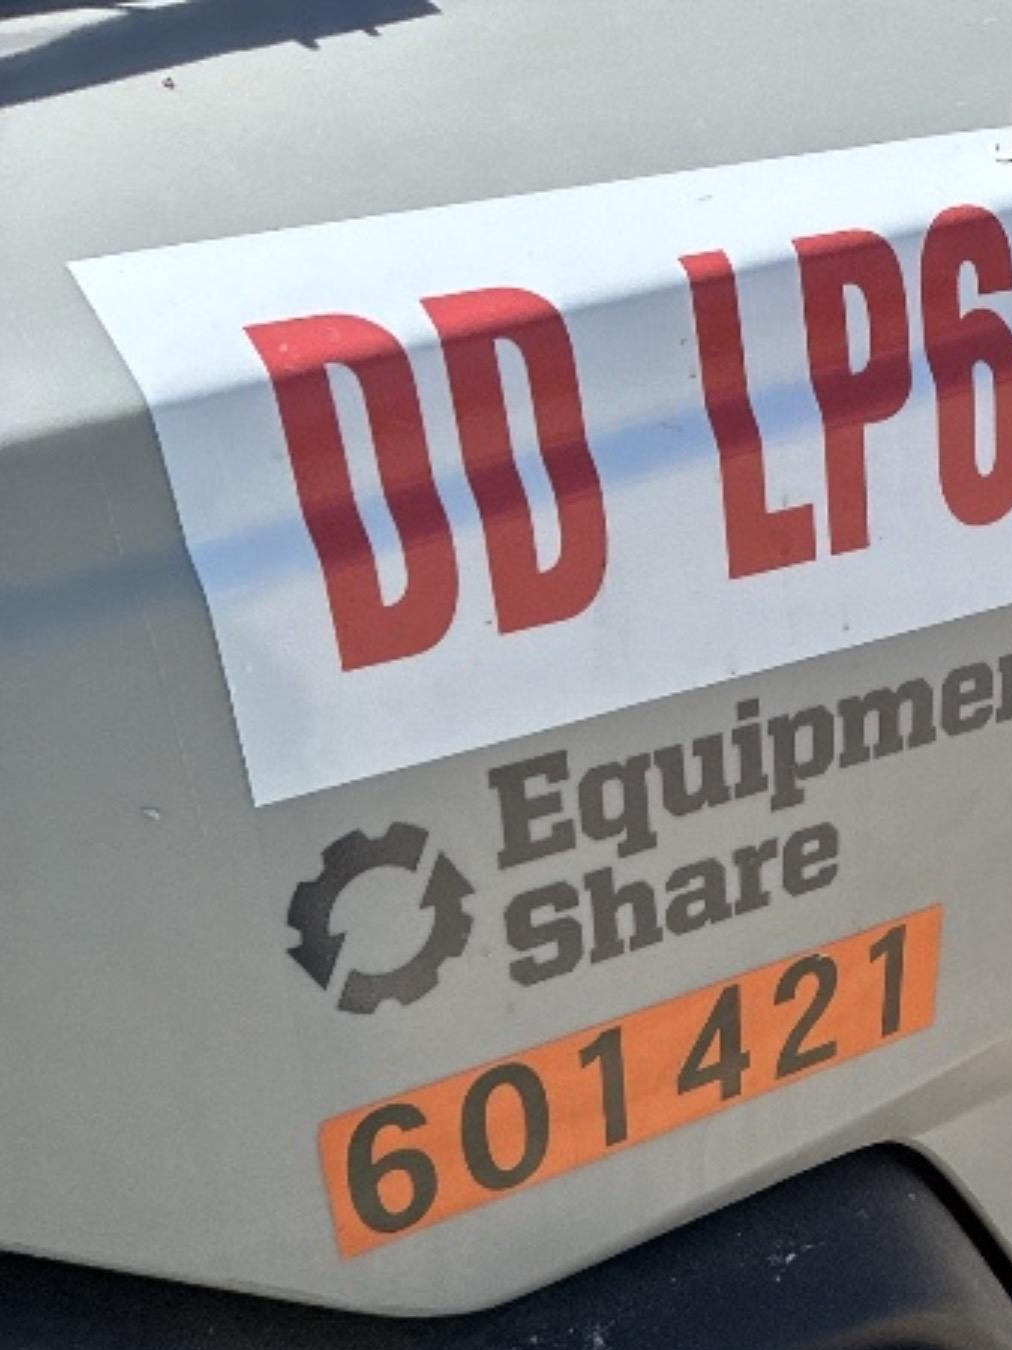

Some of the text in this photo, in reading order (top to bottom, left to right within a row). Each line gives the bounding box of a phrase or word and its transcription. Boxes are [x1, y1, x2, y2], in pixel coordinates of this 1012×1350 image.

[243, 287, 608, 671] DD
[503, 821, 839, 988] Share
[346, 924, 908, 1234] 601421
